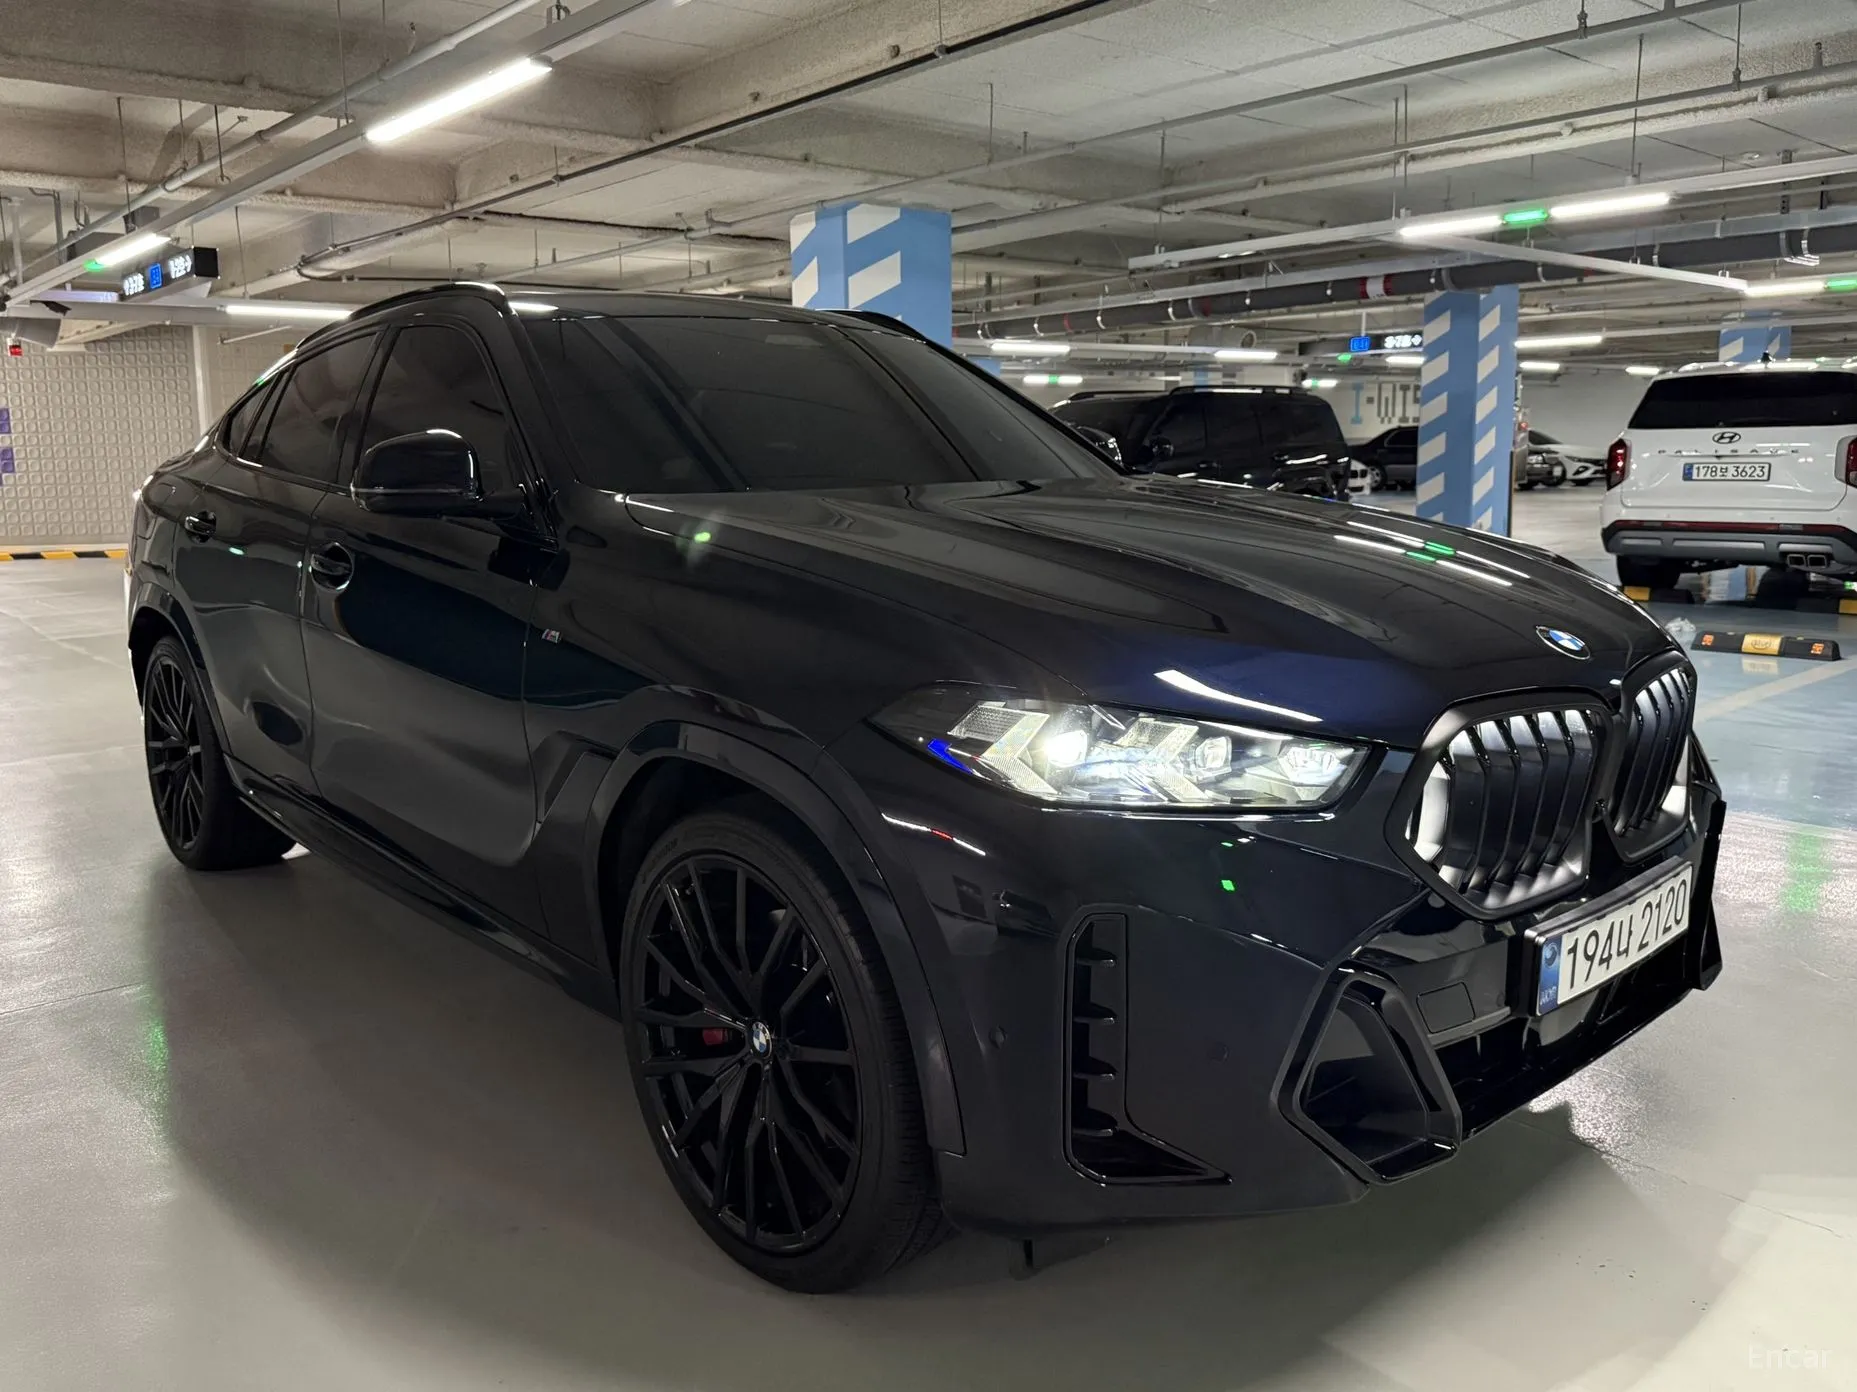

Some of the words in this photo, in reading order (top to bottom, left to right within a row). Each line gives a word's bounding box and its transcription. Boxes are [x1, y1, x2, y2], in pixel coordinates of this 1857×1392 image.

[1695, 465, 1728, 478] 178보
[1731, 465, 1765, 478] 3623
[1567, 914, 1634, 990] 194나
[1638, 879, 1687, 951] 2120
